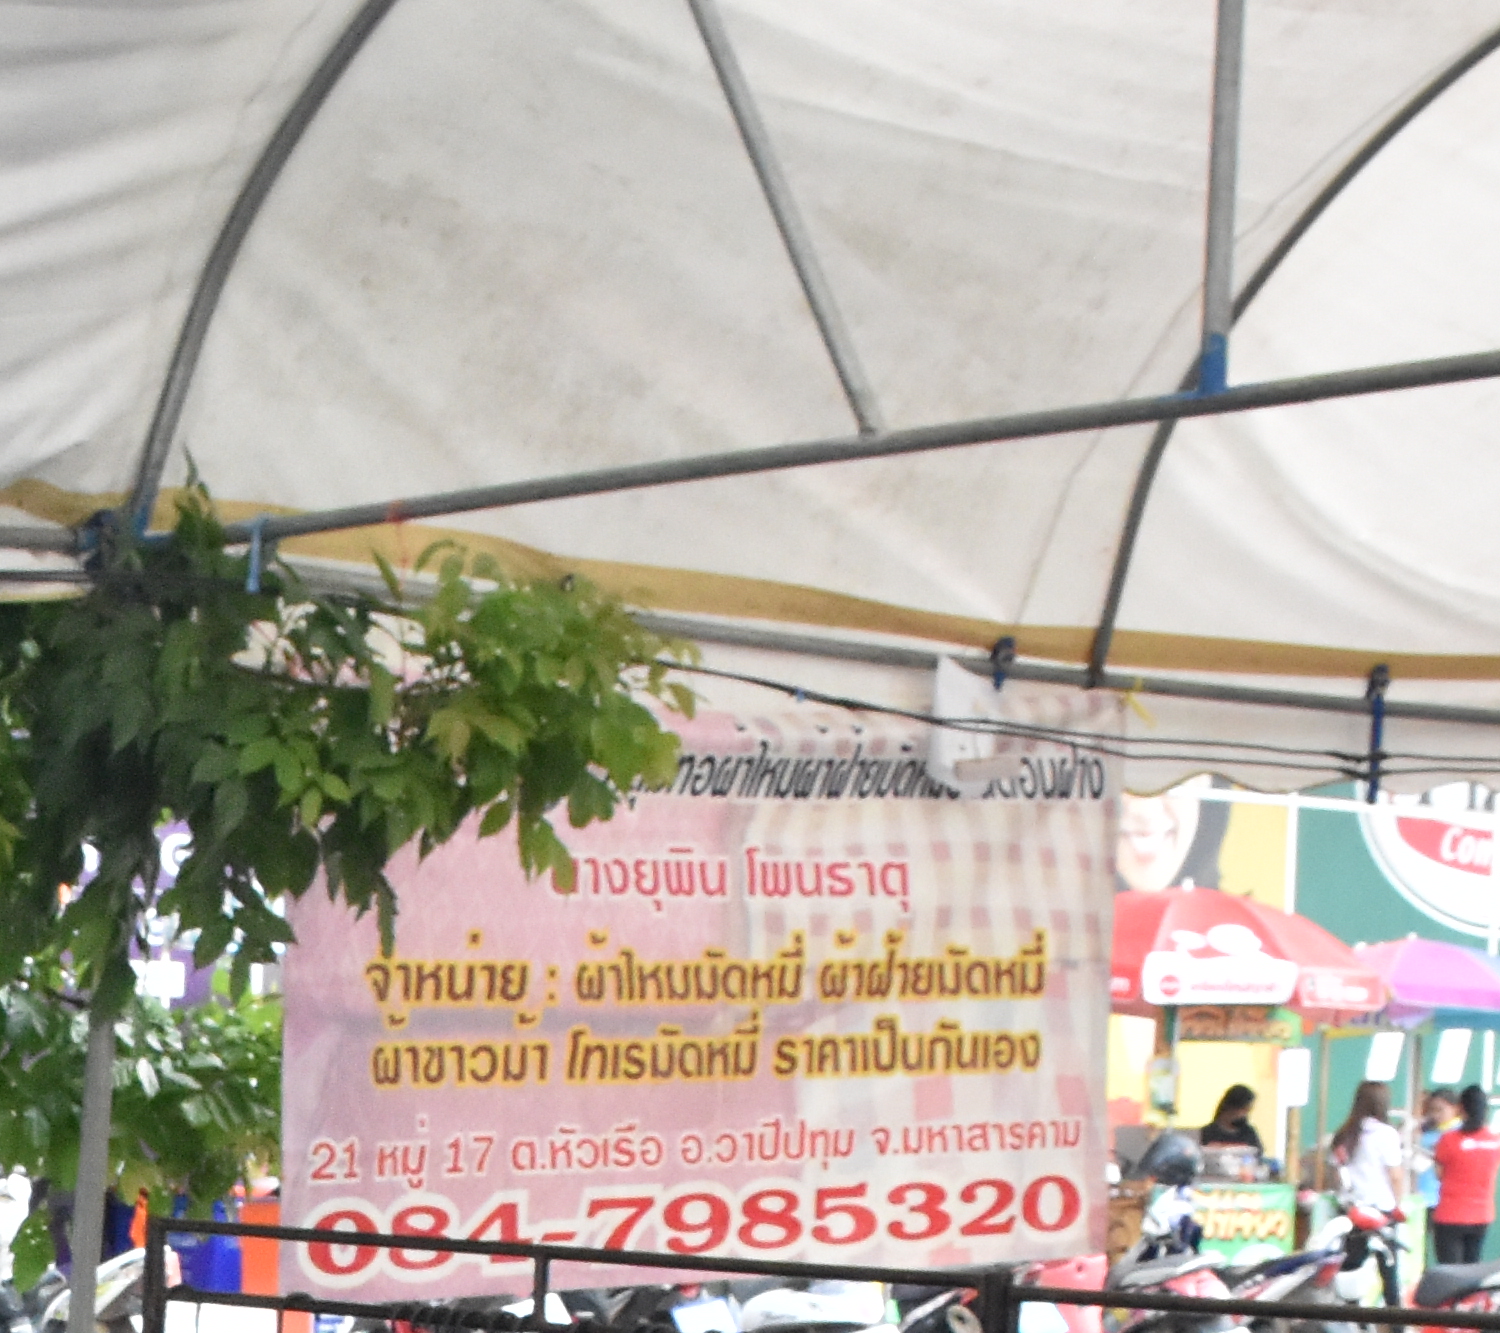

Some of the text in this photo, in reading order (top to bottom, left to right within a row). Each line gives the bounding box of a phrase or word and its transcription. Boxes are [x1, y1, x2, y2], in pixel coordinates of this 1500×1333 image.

[576, 931, 804, 1001] ผ้าไหมมัดหมี่
[820, 930, 1046, 998] ผ้าฝ้ายมัดหมี่
[373, 1012, 549, 1085] ผ้าขาวม้า
[774, 1015, 1042, 1077] ราคาเป็นกันเอง
[311, 1141, 359, 1181] 21
[377, 1118, 428, 1189] หมู่
[446, 1136, 495, 1174] 17
[307, 1175, 1081, 1275] 084-7985320
